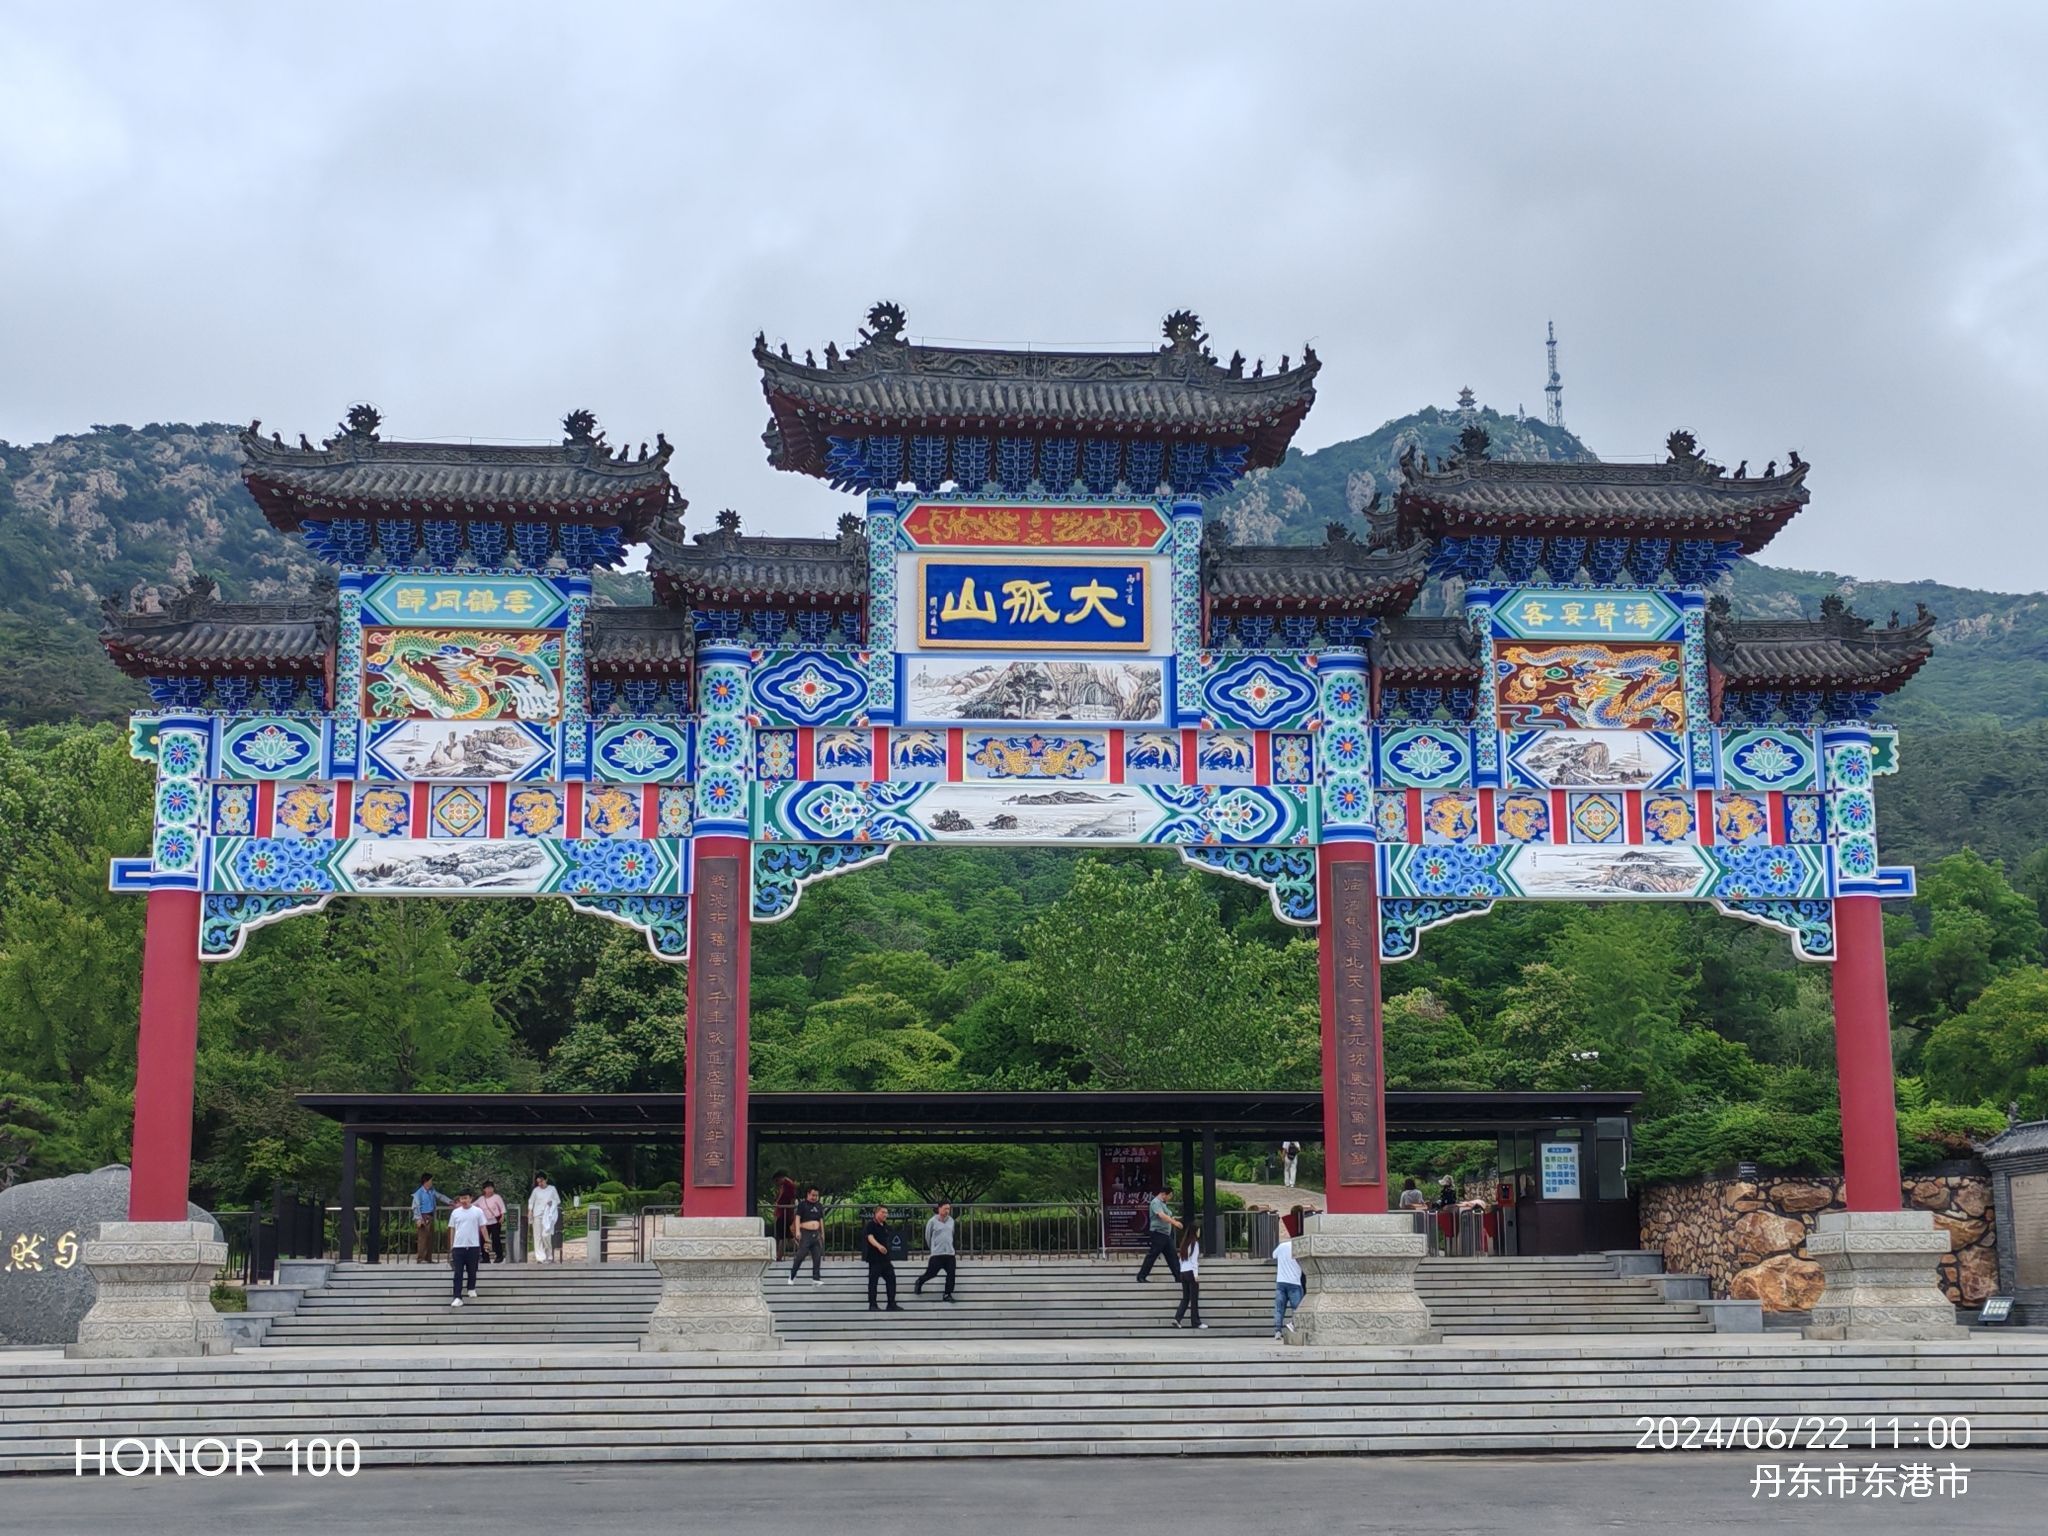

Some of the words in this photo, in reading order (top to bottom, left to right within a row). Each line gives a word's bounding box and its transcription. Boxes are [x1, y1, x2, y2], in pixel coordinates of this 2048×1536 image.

[940, 577, 1127, 628] 大孤山
[1520, 602, 1656, 631] 濤聲宴客
